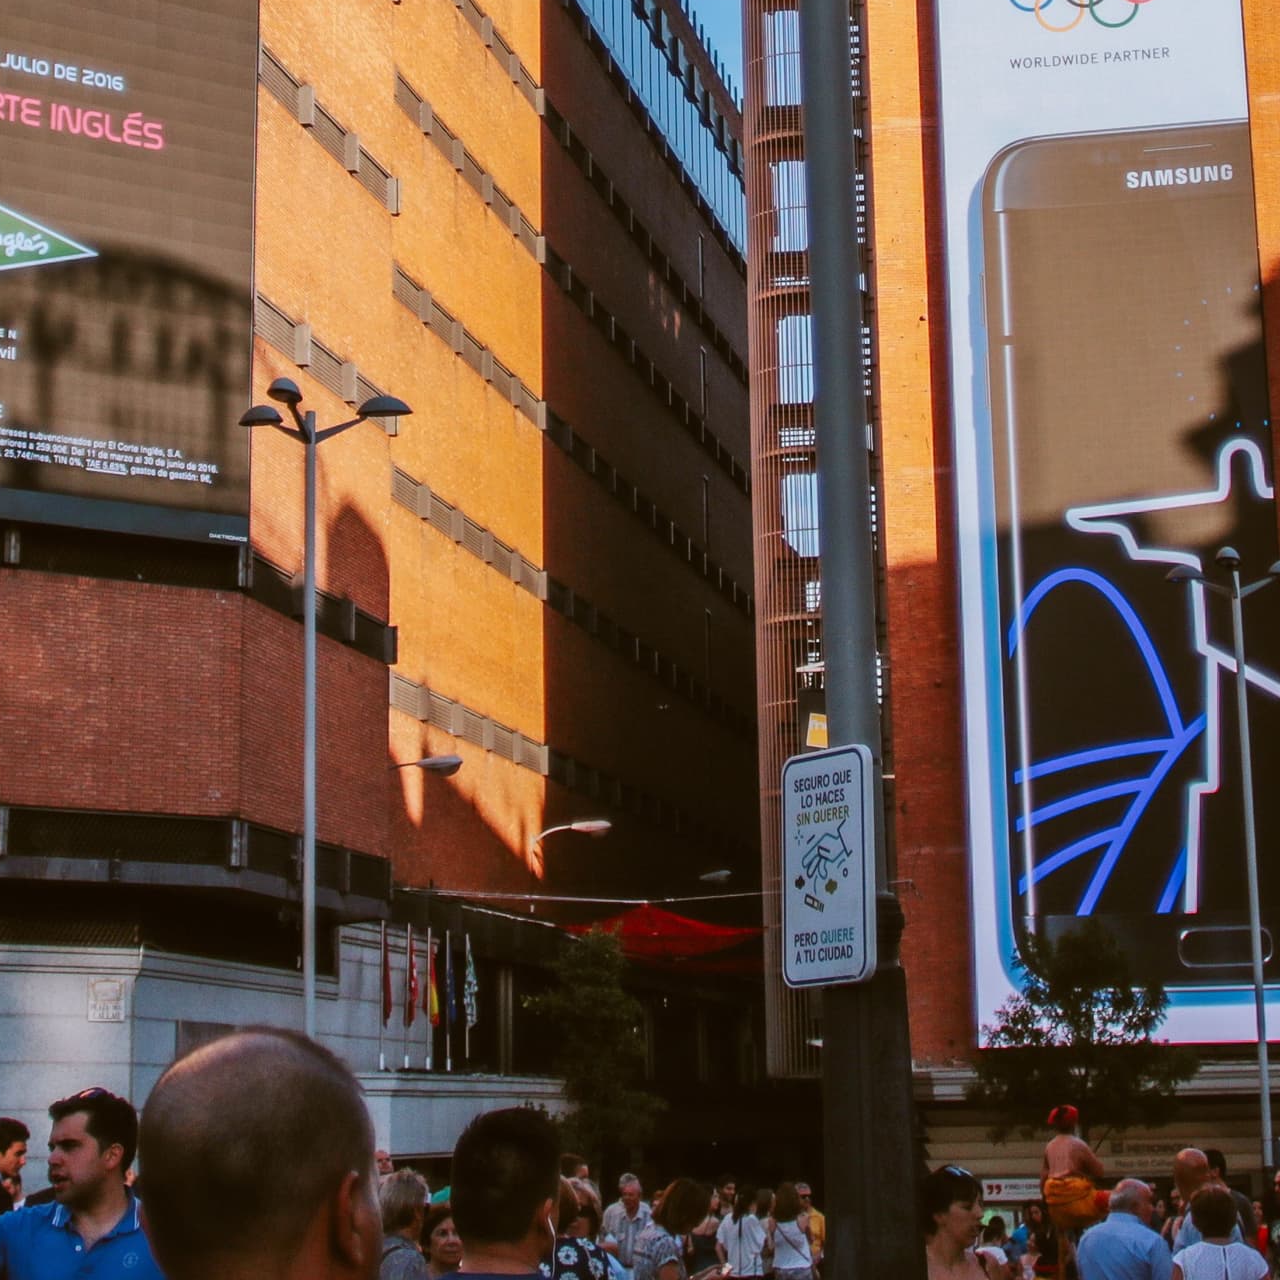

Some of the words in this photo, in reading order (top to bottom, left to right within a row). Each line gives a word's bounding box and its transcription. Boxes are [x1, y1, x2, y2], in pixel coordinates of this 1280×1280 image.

[1010, 52, 1099, 70] WORLDWIDE
[1104, 47, 1171, 63] PARTNER
[0, 53, 49, 77] JULIO
[54, 62, 79, 82] DE
[82, 69, 124, 92] 2016
[50, 102, 164, 151] INGLÉS
[1126, 164, 1233, 189] SAMSUNG
[794, 773, 830, 793] SEGURO
[832, 770, 852, 785] QUE
[801, 794, 813, 809] LO
[816, 789, 845, 805] HACES
[796, 811, 811, 827] SIN
[813, 805, 850, 824] QUERER
[794, 932, 818, 948] PERO
[820, 927, 854, 944] QUIERE
[795, 952, 803, 965] A
[803, 950, 816, 963] TU
[818, 945, 853, 962] CIUDAD
